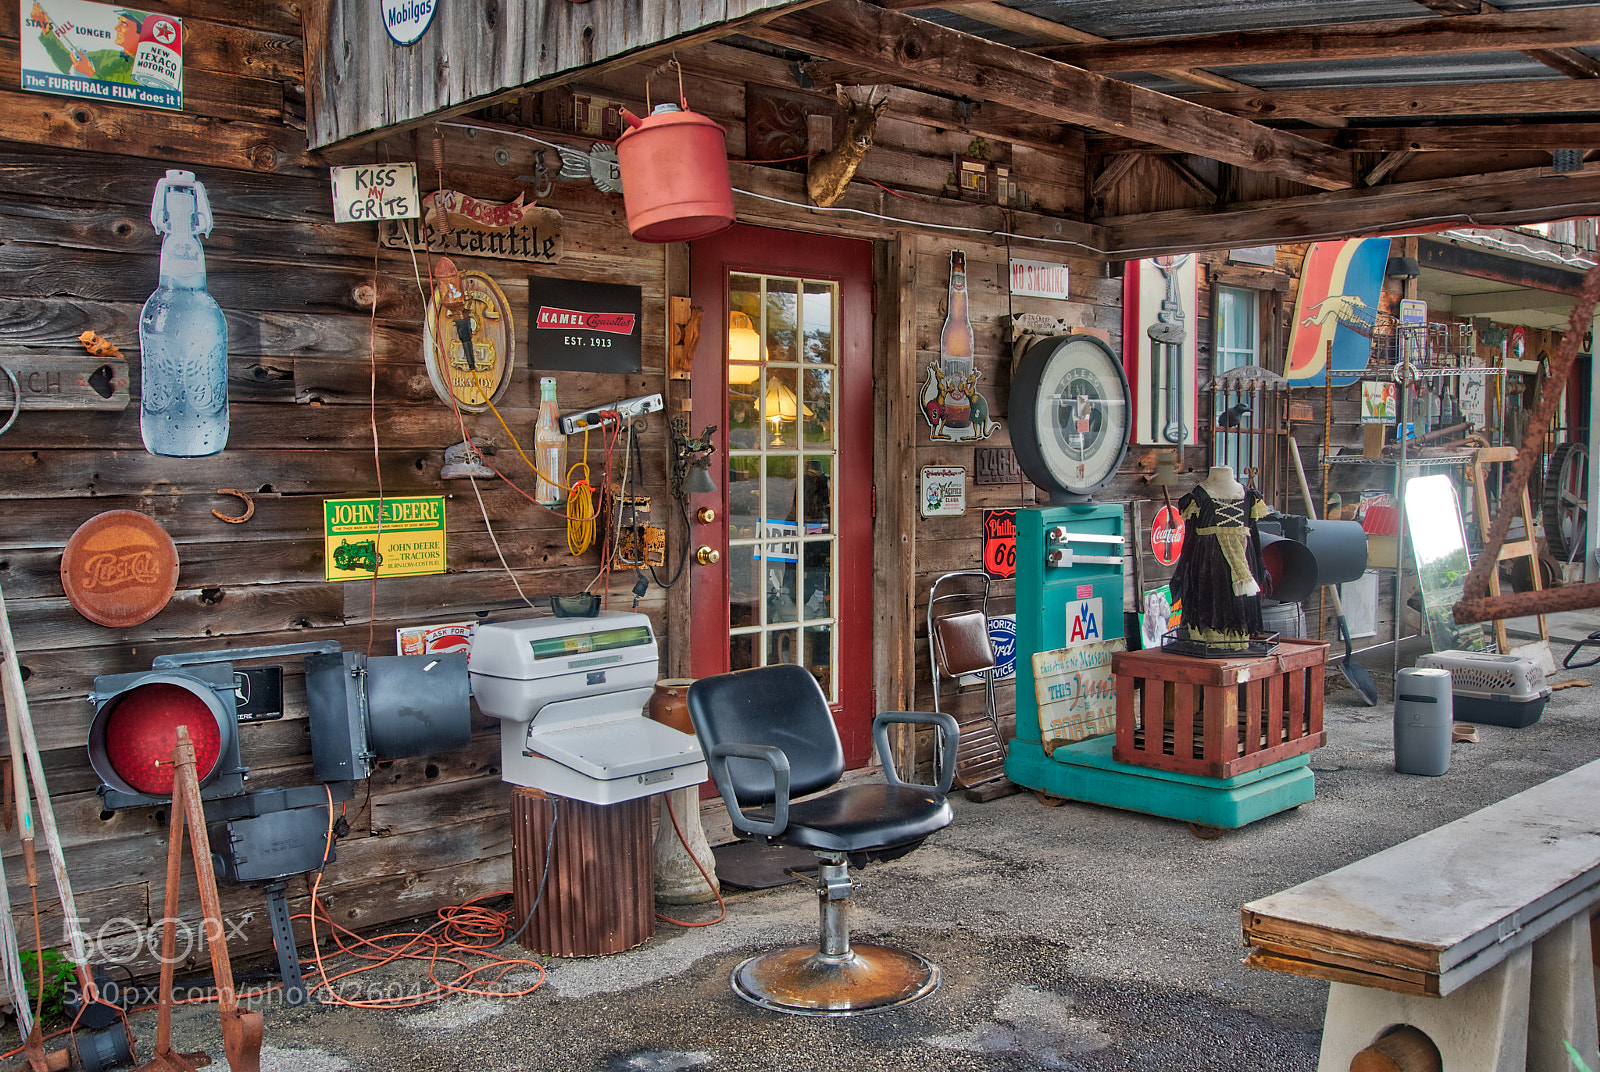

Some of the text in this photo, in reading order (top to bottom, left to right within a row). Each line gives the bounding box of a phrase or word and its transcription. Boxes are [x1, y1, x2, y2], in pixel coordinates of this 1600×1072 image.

[388, 0, 431, 27] Mobilgas
[25, 18, 111, 39] STAYS FULL LONGER
[140, 52, 177, 72] TEXACO
[151, 47, 170, 58] NEW
[137, 60, 164, 74] MOTOR
[165, 68, 176, 80] OIL
[26, 75, 46, 87] The
[140, 91, 164, 104] does
[355, 168, 397, 190] KISS
[349, 196, 409, 220] GRITS
[1012, 263, 1065, 294] NO SMOKING
[541, 312, 584, 326] KAMEL
[564, 336, 612, 348] EST. 1913
[1060, 369, 1100, 388] TOLEDO
[932, 408, 938, 420] S
[331, 504, 374, 524] JOHN
[392, 502, 440, 521] DEERE
[387, 541, 440, 552] JOHN DEERE
[400, 551, 440, 560] TRACTORS
[995, 543, 1016, 567] 66
[432, 629, 447, 639] ASK
[1048, 682, 1071, 700] THIS
[1084, 701, 1091, 710] IS
[1050, 714, 1085, 740] FOR
